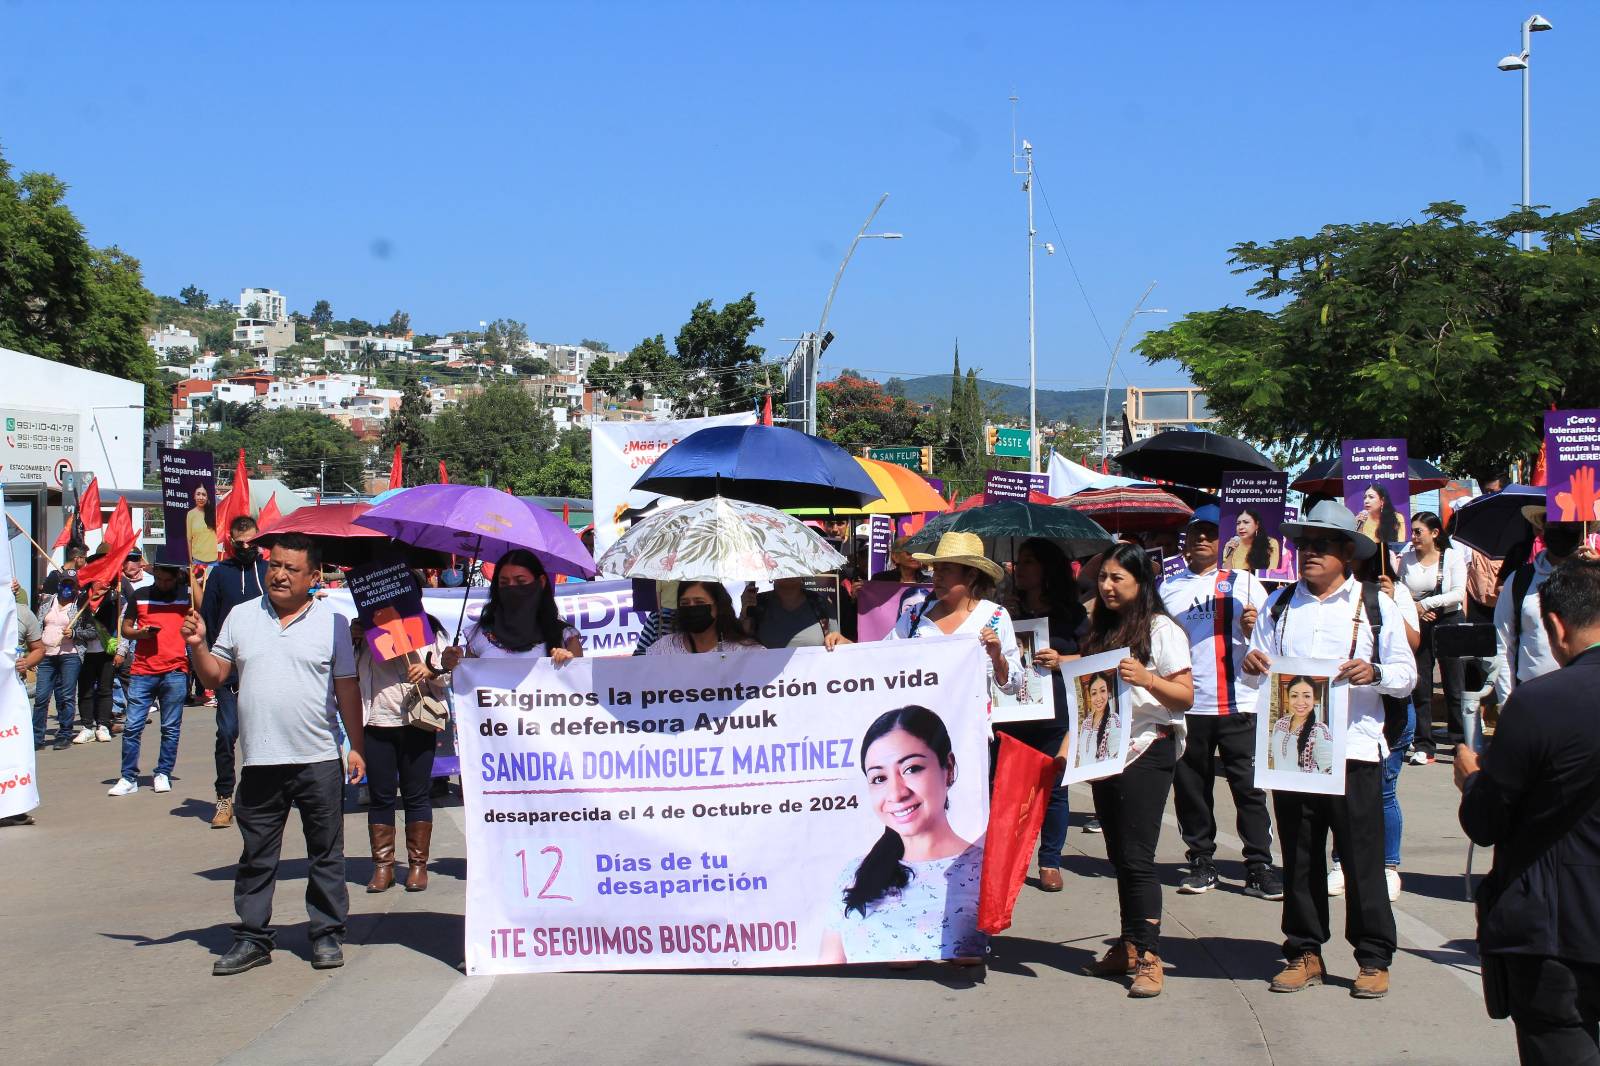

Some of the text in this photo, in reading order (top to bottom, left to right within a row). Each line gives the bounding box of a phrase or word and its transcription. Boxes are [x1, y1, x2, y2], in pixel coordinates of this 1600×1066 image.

[1567, 416, 1596, 426] ¡Cero
[163, 454, 172, 463] ¡Ni
[880, 452, 894, 460] SAN
[1366, 454, 1398, 462] mujeres
[164, 465, 212, 476] desaparecida
[1375, 472, 1405, 480] peligro!
[1232, 478, 1254, 486] ¡Viva
[166, 489, 174, 498] ¡Ni
[166, 500, 190, 508] menos!
[366, 563, 406, 582] primavera
[354, 584, 370, 594] debe
[372, 578, 392, 588] llegar
[366, 582, 400, 597] MUJERES
[360, 586, 412, 606] OAXAQUEÑAS!
[476, 669, 938, 711] Exigimos la presentación con vida
[480, 710, 778, 736] de la defensora Ayuuk
[482, 736, 854, 782] SANDRA DOMÍNGUEZ MARTÍNEZ
[484, 795, 858, 826] desaparecida el 4 de Octubre de 2024
[596, 852, 728, 872] Días de tu
[516, 845, 574, 901] 12
[597, 872, 768, 898] desaparición
[490, 921, 797, 958] ¡TE SEGUIMOS BUSCANDO!
